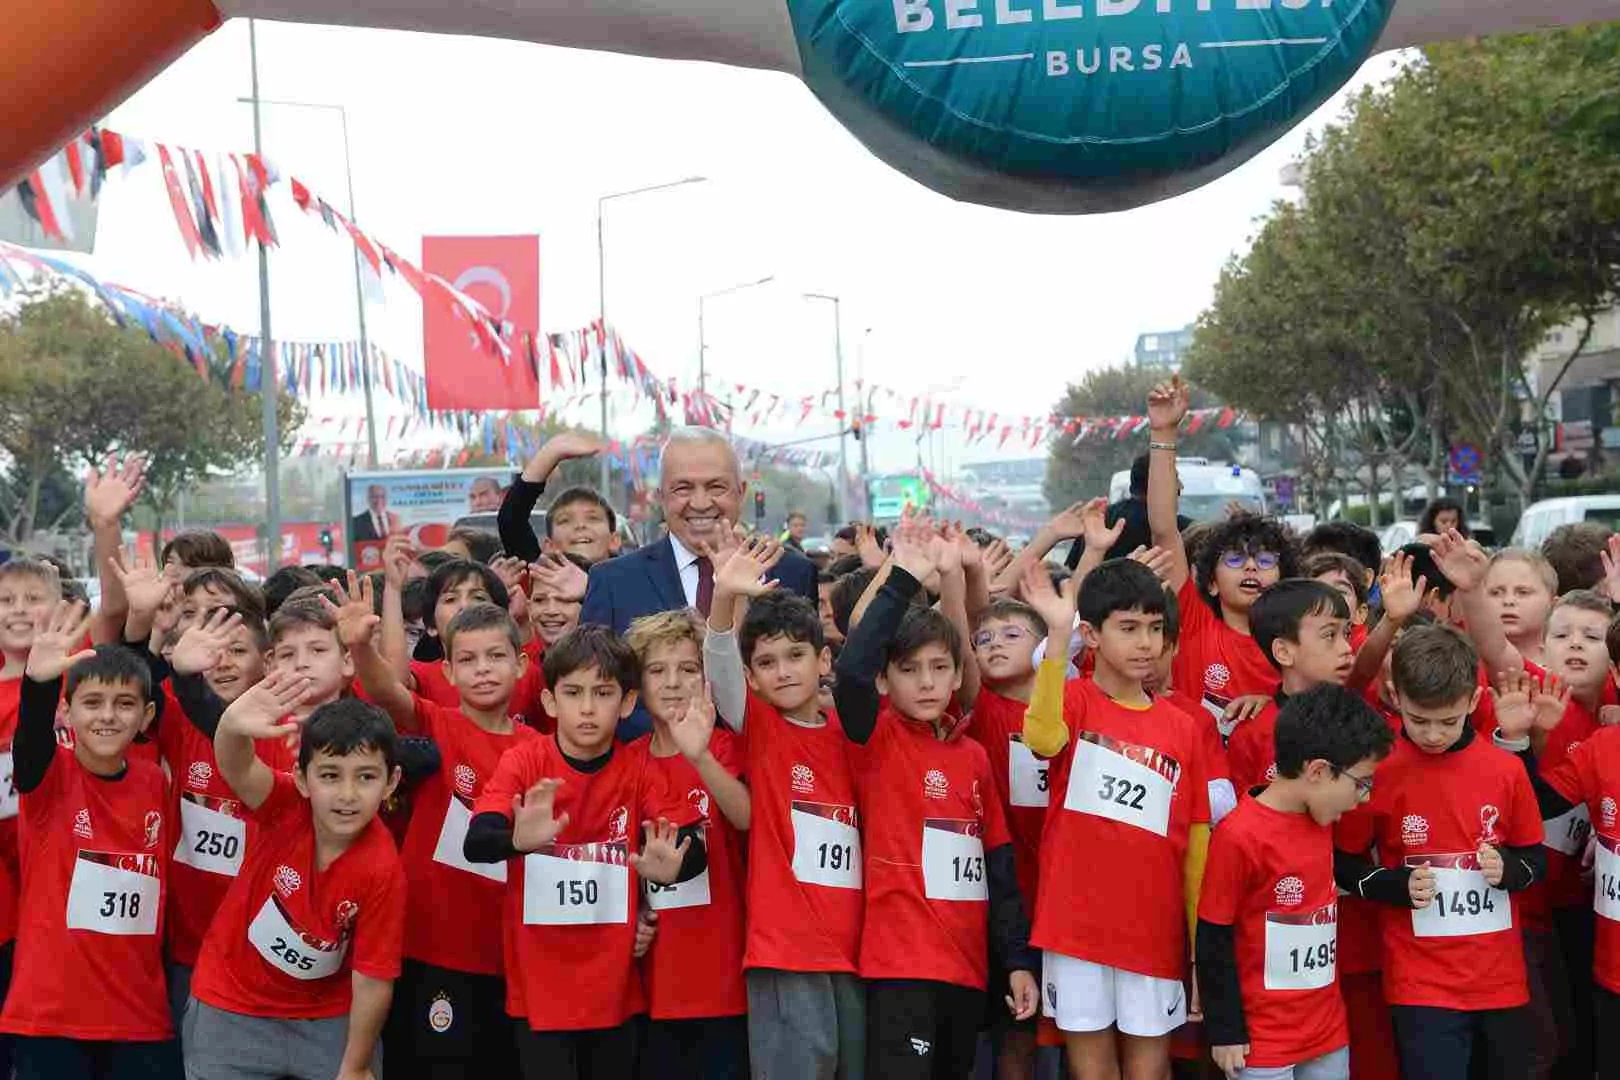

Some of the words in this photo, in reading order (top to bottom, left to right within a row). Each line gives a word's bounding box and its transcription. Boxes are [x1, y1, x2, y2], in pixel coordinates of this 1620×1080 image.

[1047, 42, 1193, 77] BURSA
[1098, 774, 1147, 811] 322
[194, 830, 239, 859] 250
[818, 843, 852, 871] 191
[952, 856, 983, 882] 143
[100, 891, 141, 918] 318
[556, 879, 599, 906] 150
[1435, 887, 1494, 917] 1494
[270, 937, 317, 970] 265
[1289, 939, 1336, 973] 1495
